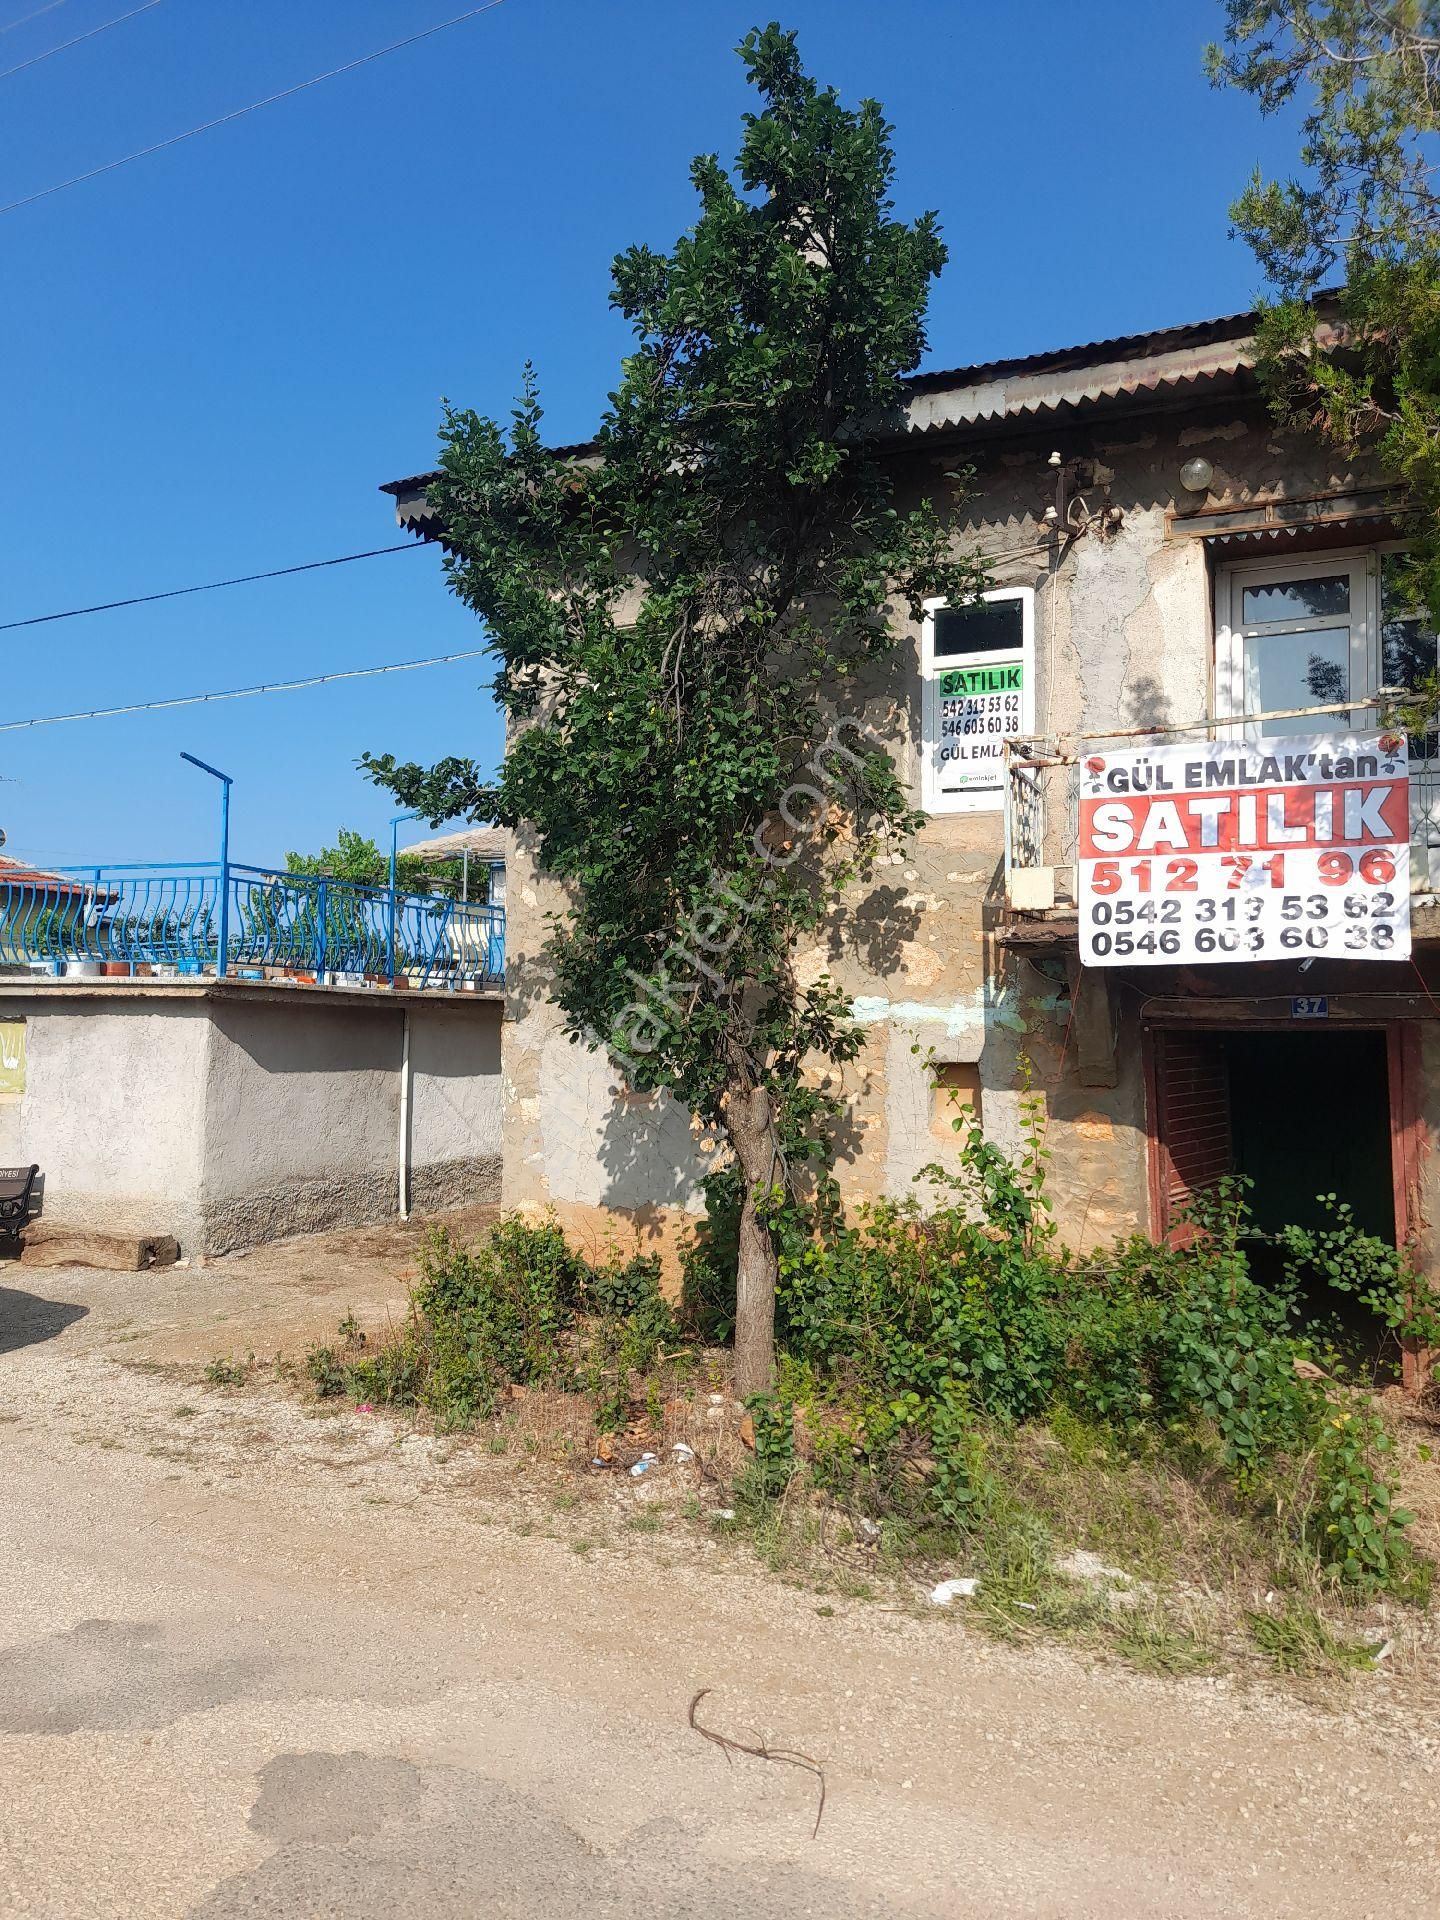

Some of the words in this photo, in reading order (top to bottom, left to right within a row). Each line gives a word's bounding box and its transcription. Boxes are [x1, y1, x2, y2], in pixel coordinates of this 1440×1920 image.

[943, 669, 1020, 694] SATILIK
[943, 700, 963, 717] 542
[966, 698, 985, 715] 313
[988, 696, 1001, 712] 53
[1004, 695, 1018, 711] 62
[941, 720, 961, 738] 546
[963, 718, 985, 735] 603
[988, 717, 1001, 733] 60
[1005, 716, 1018, 732] 38
[940, 743, 968, 760] GÜL
[1107, 757, 1173, 793] GÜL
[1185, 753, 1378, 788] EMLAK'tan
[1091, 786, 1395, 852] SATILIK
[1091, 857, 1198, 895] 512
[1221, 853, 1284, 889] 71
[1317, 849, 1396, 886] 96
[1091, 900, 1181, 926] 0542
[1195, 897, 1264, 922] 313
[1280, 894, 1328, 920] 53
[1344, 892, 1395, 918] 62
[1091, 929, 1181, 956] 0546
[1195, 926, 1264, 952] 603
[1280, 925, 1328, 949] 60
[1344, 924, 1394, 950] 38
[1296, 997, 1322, 1013] 37
